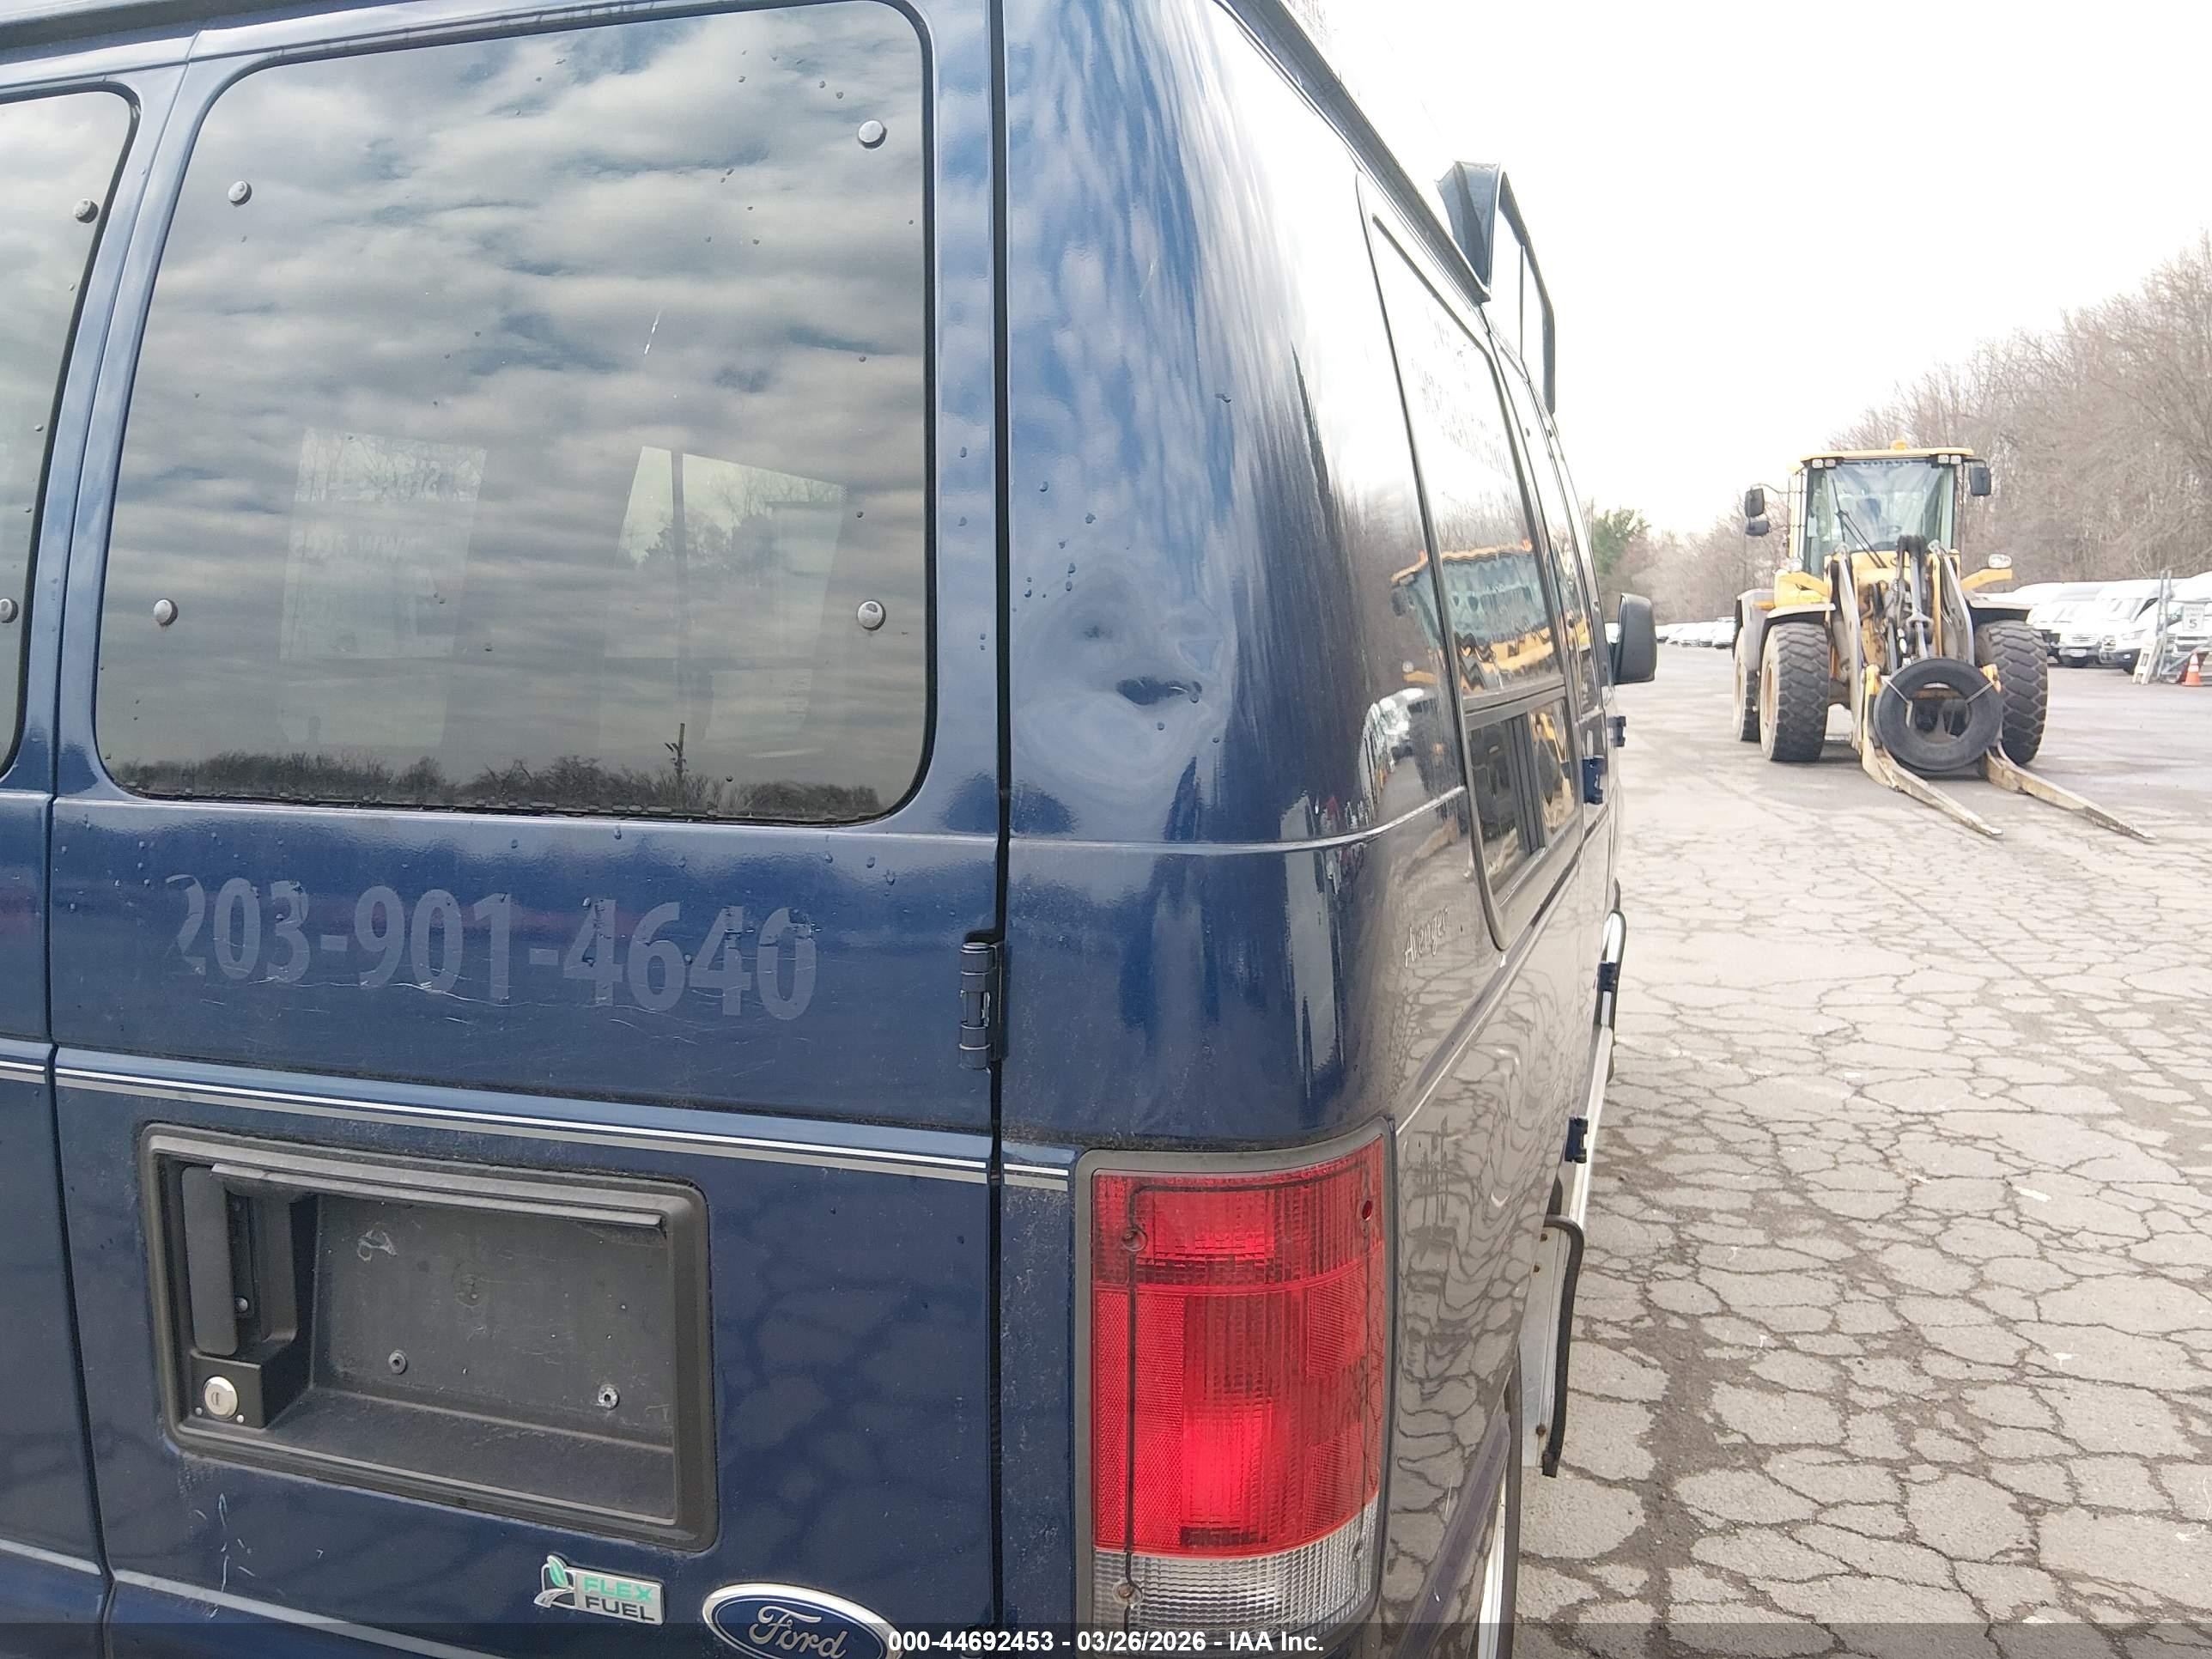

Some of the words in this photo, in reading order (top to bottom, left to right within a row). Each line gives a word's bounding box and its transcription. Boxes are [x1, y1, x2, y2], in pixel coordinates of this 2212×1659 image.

[2189, 618, 2197, 629] 5
[165, 873, 817, 1020] 203-901-4640
[584, 1577, 654, 1602] FLEX
[585, 1595, 655, 1621] FUEL
[749, 1605, 848, 1659] Ford
